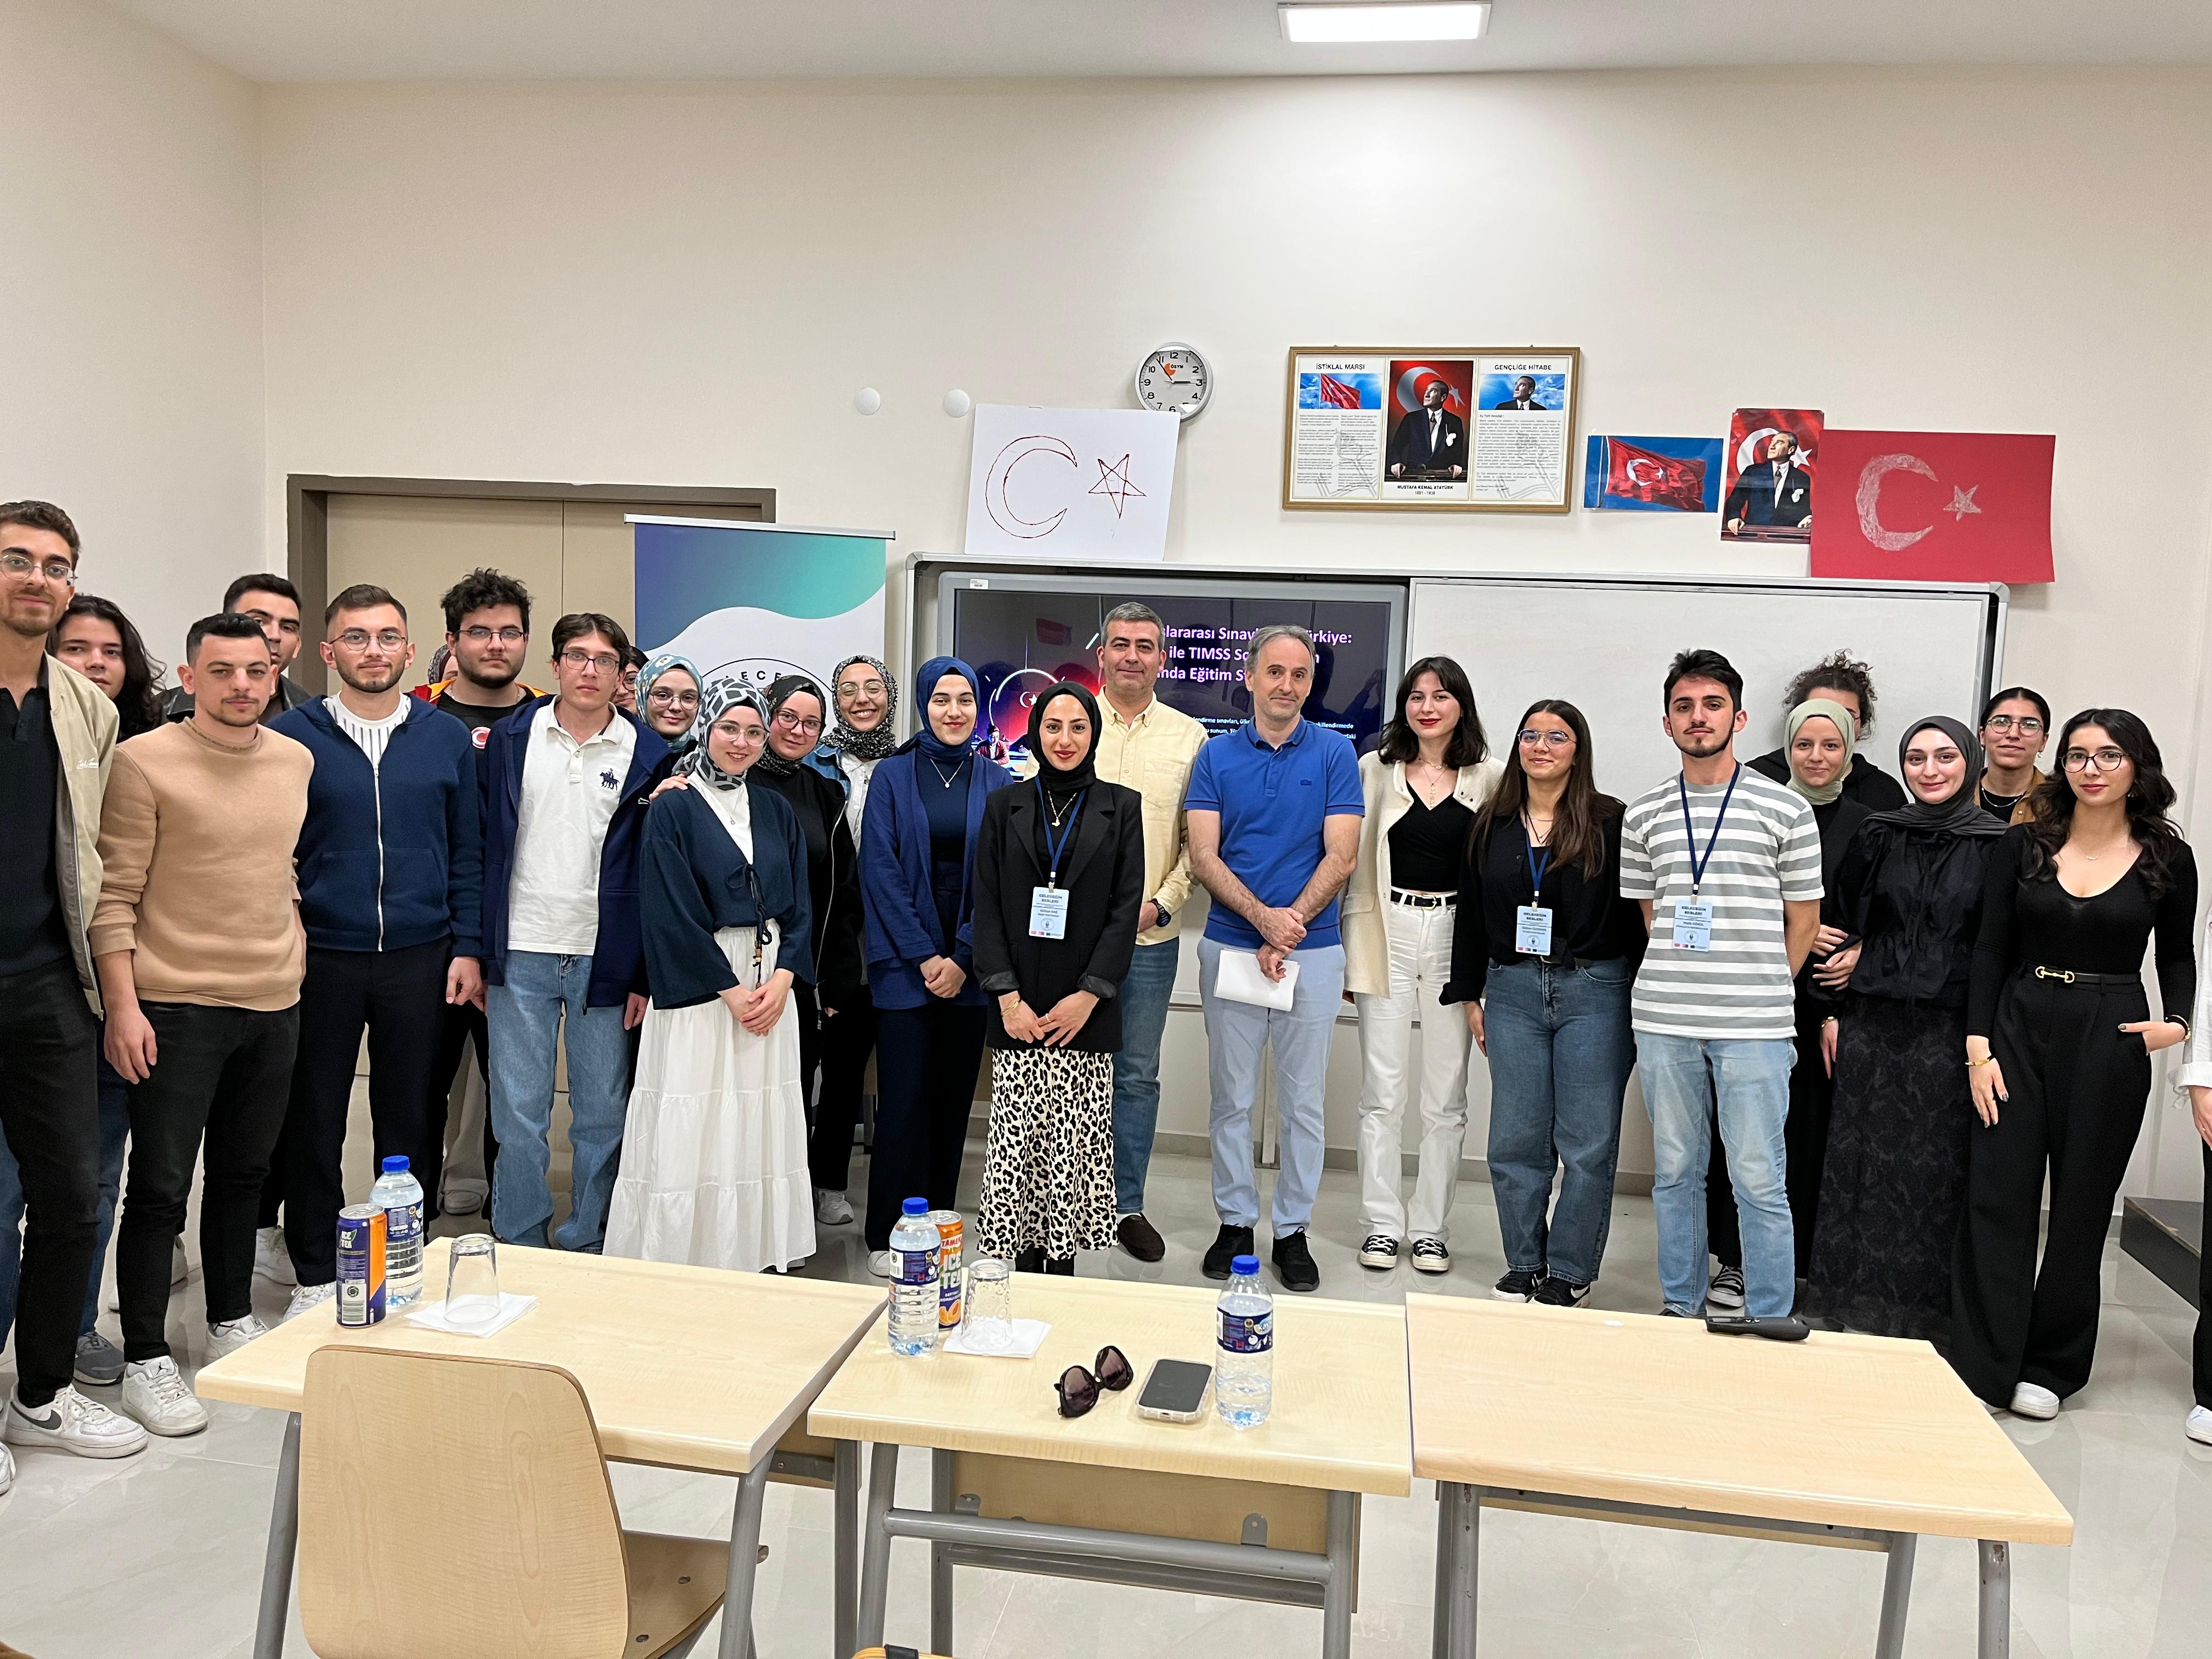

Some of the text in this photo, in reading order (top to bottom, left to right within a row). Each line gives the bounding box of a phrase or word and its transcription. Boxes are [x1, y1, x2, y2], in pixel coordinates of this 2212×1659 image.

[1164, 625, 1215, 639] lararası
[1218, 627, 1259, 640] Sınav
[1169, 646, 1185, 658] ile
[1188, 647, 1231, 660] TIMSS
[1190, 667, 1232, 682] Eğitim
[342, 1231, 352, 1240] ICE
[342, 1239, 352, 1248] TEA
[944, 1251, 961, 1271] ICE
[943, 1269, 961, 1289] TEA
